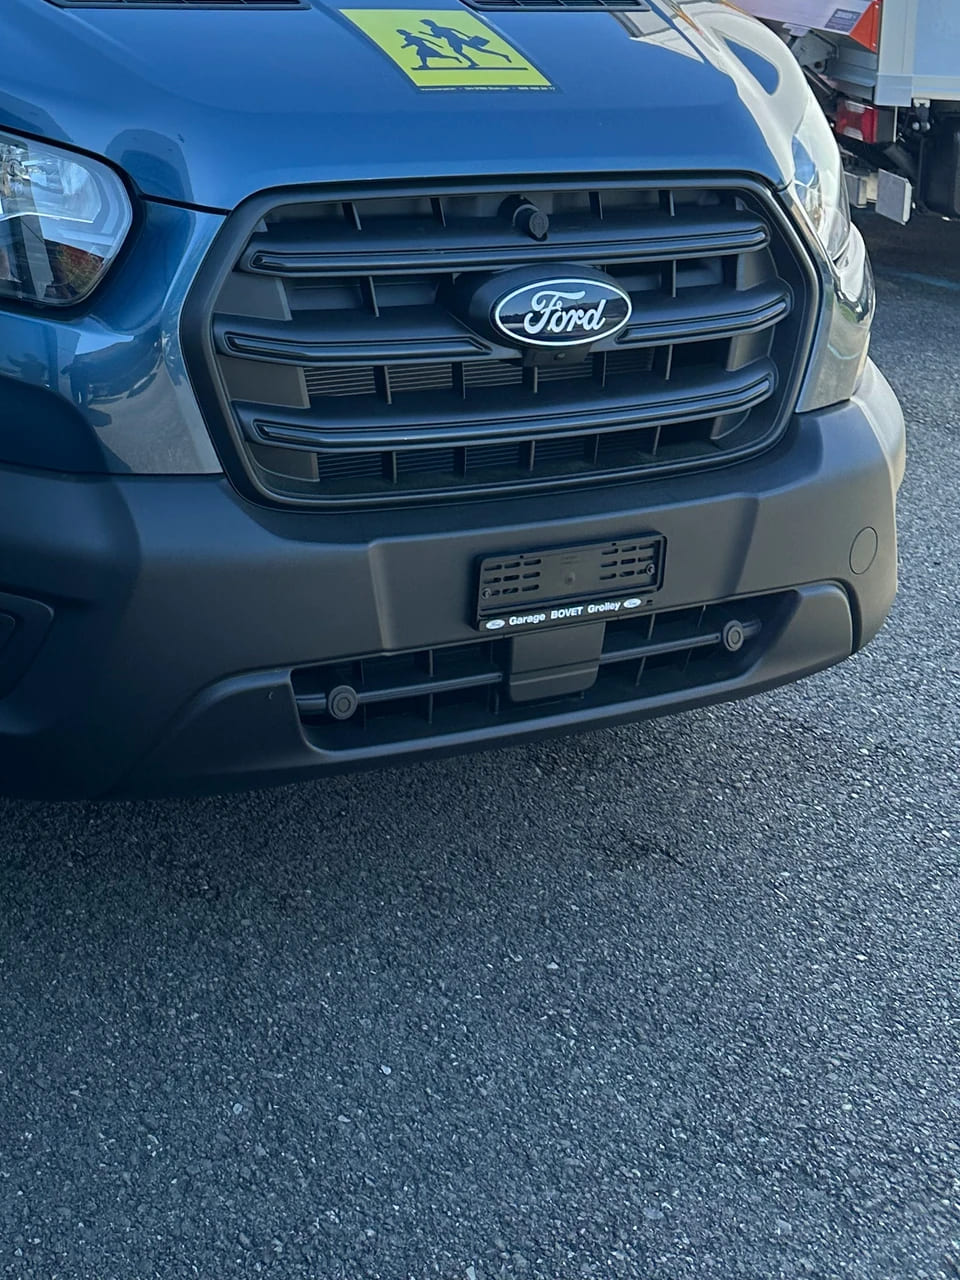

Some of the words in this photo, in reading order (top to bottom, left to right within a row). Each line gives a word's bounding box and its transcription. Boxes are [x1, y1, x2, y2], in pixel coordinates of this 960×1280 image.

[523, 290, 607, 335] Ford
[509, 613, 546, 626] Garage
[550, 606, 584, 619] BOVET
[587, 601, 621, 614] Grolley
